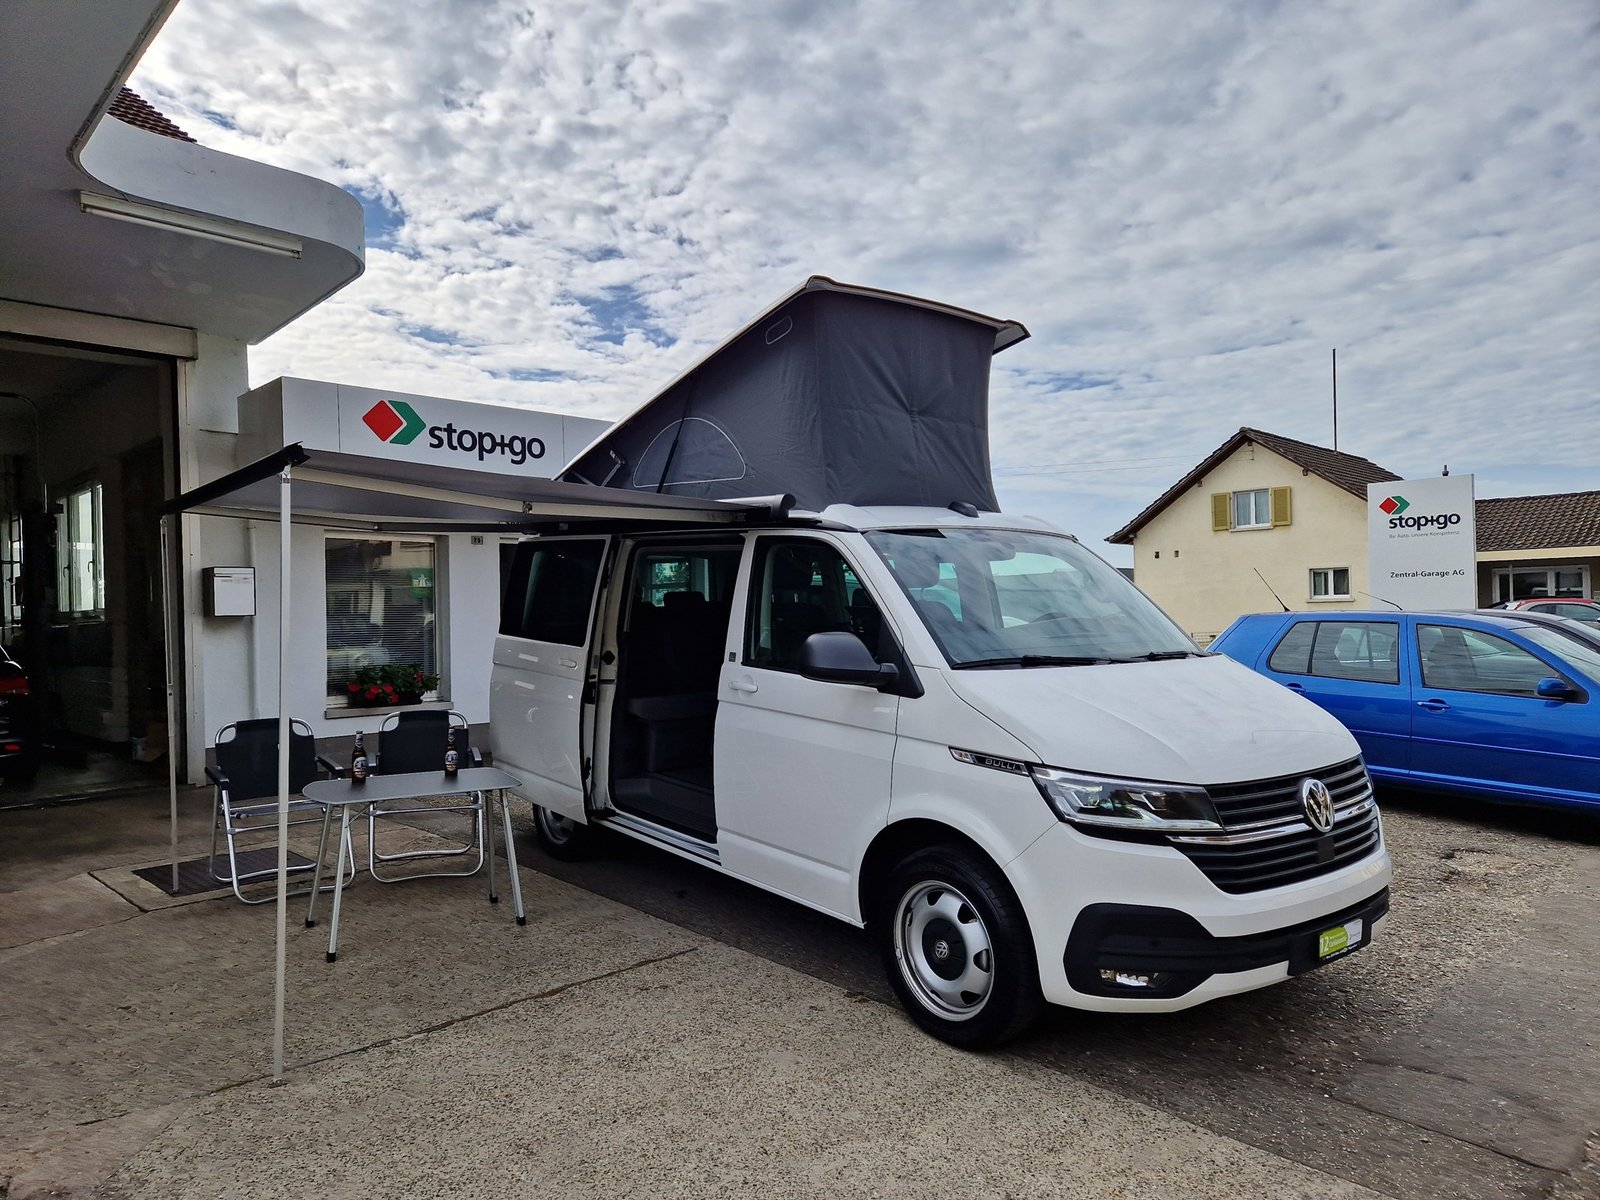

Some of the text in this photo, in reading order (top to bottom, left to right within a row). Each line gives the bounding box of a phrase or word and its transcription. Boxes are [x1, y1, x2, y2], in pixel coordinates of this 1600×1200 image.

[428, 422, 546, 465] stop+go
[1388, 513, 1461, 531] stop+go
[1390, 570, 1450, 578] Zentral-Garage
[985, 758, 1016, 770] BULLI
